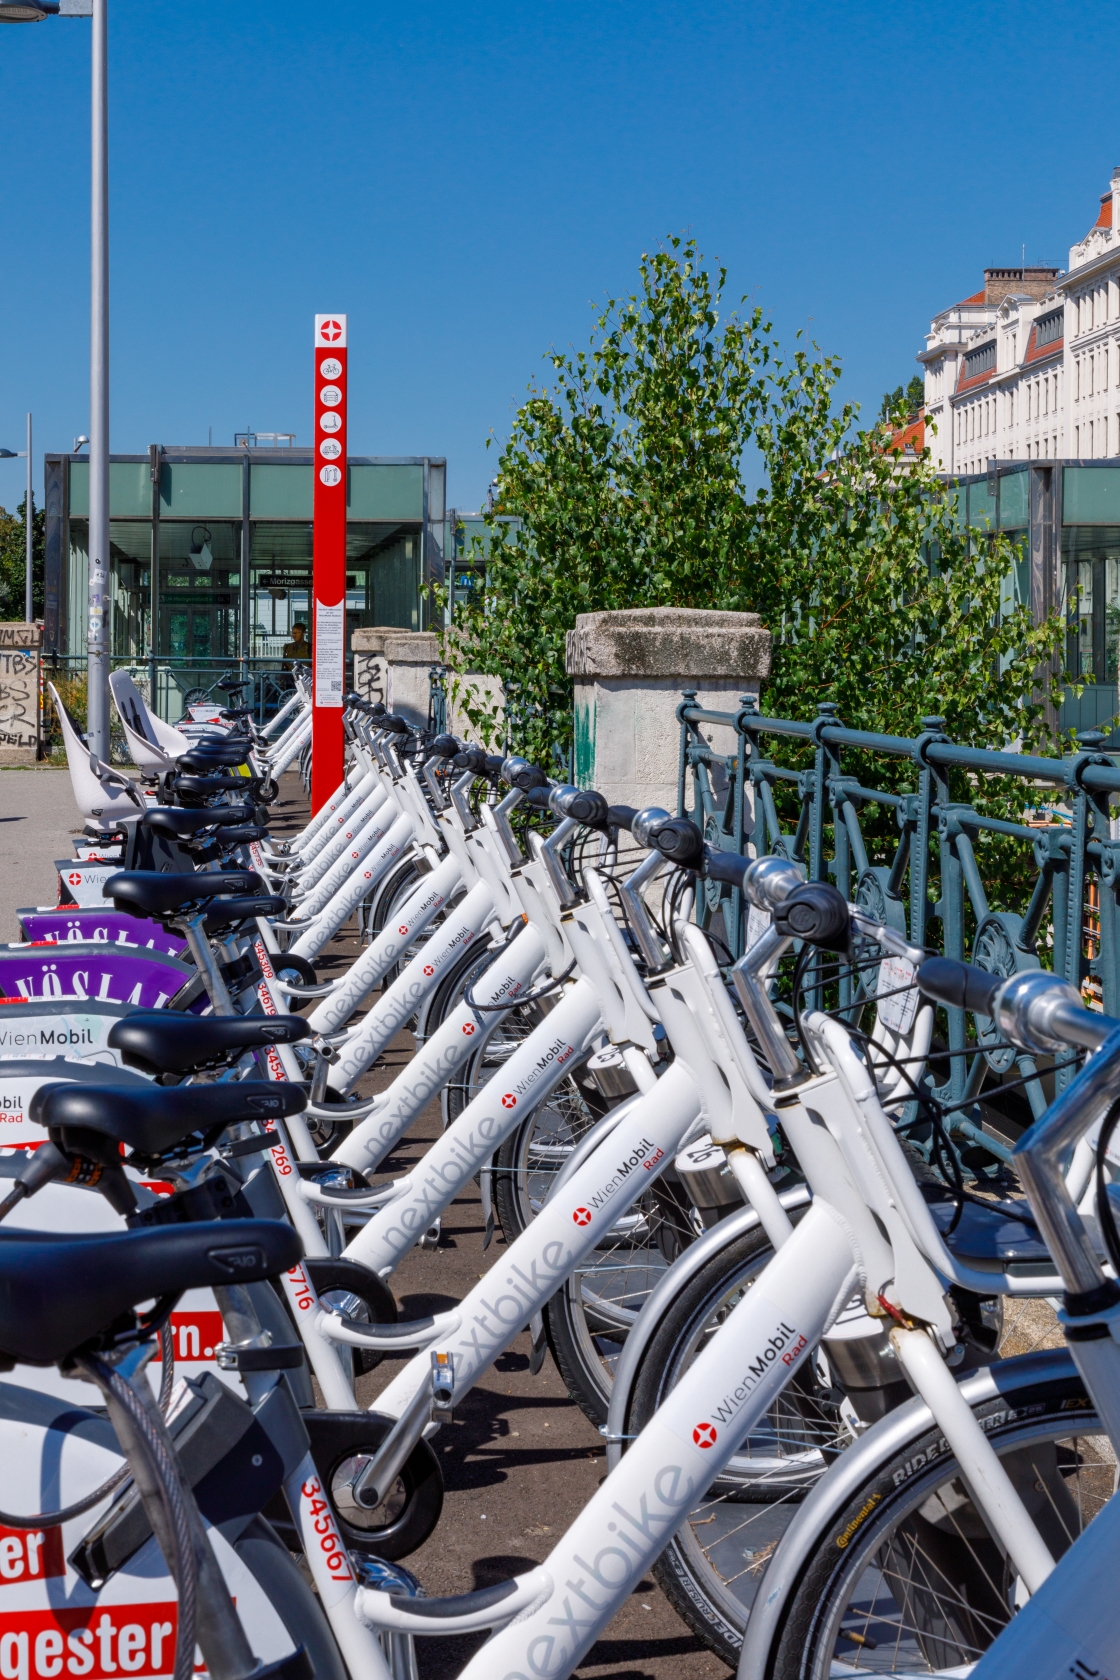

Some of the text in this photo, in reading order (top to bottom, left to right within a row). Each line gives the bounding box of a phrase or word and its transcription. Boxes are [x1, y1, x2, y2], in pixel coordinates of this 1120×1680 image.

[297, 814, 331, 851] extbike
[351, 810, 373, 834] WienMobil
[358, 827, 381, 854] WienMobil
[371, 843, 396, 873] WienMobil
[307, 885, 364, 951] nextbike
[405, 891, 440, 927] WienMobil
[433, 896, 444, 908] Rad
[431, 926, 470, 967] WienMobil
[462, 931, 475, 945] Rad
[253, 940, 274, 979] 345309
[322, 942, 400, 1025] nextbike
[508, 982, 522, 998] Rad
[340, 981, 428, 1078] nextbike
[513, 1038, 567, 1095] WienMobil
[557, 1045, 575, 1065] Rad
[362, 1044, 459, 1161] nextbike
[587, 1137, 655, 1211] WienMobil
[643, 1148, 665, 1171] Rad
[381, 1115, 502, 1252] nextbike
[453, 1240, 573, 1382] extbike
[782, 1334, 808, 1367] Rad
[711, 1321, 797, 1426] WienMobil
[300, 1475, 353, 1583] 345667
[682, 1578, 717, 1622] CRUISER
